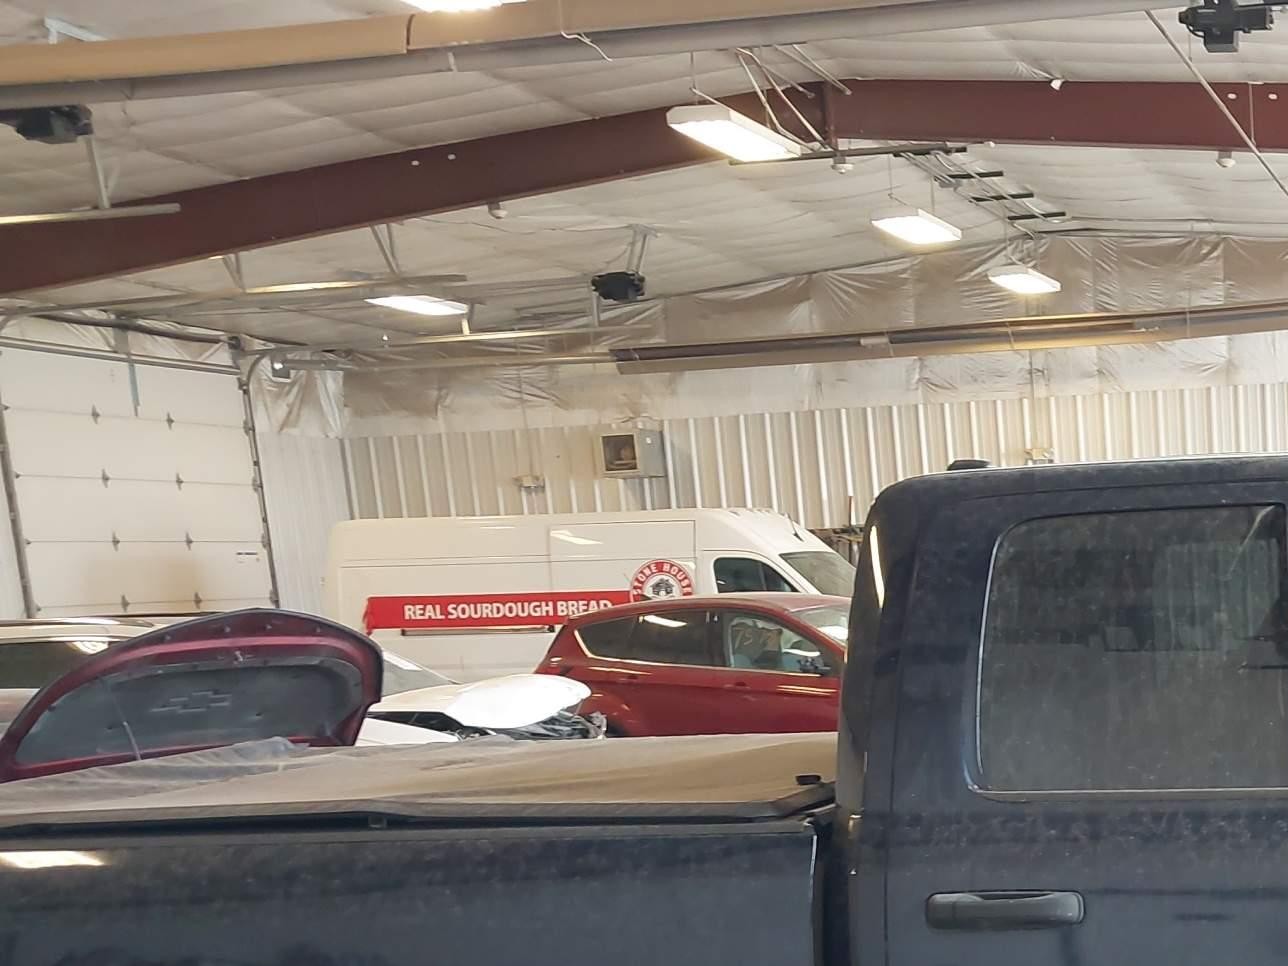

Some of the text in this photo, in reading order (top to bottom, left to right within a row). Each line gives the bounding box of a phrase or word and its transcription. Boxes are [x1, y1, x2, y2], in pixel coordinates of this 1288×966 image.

[632, 563, 692, 595] STONE HOUSE
[403, 600, 613, 619] REAL SOURDOUGH BREAD
